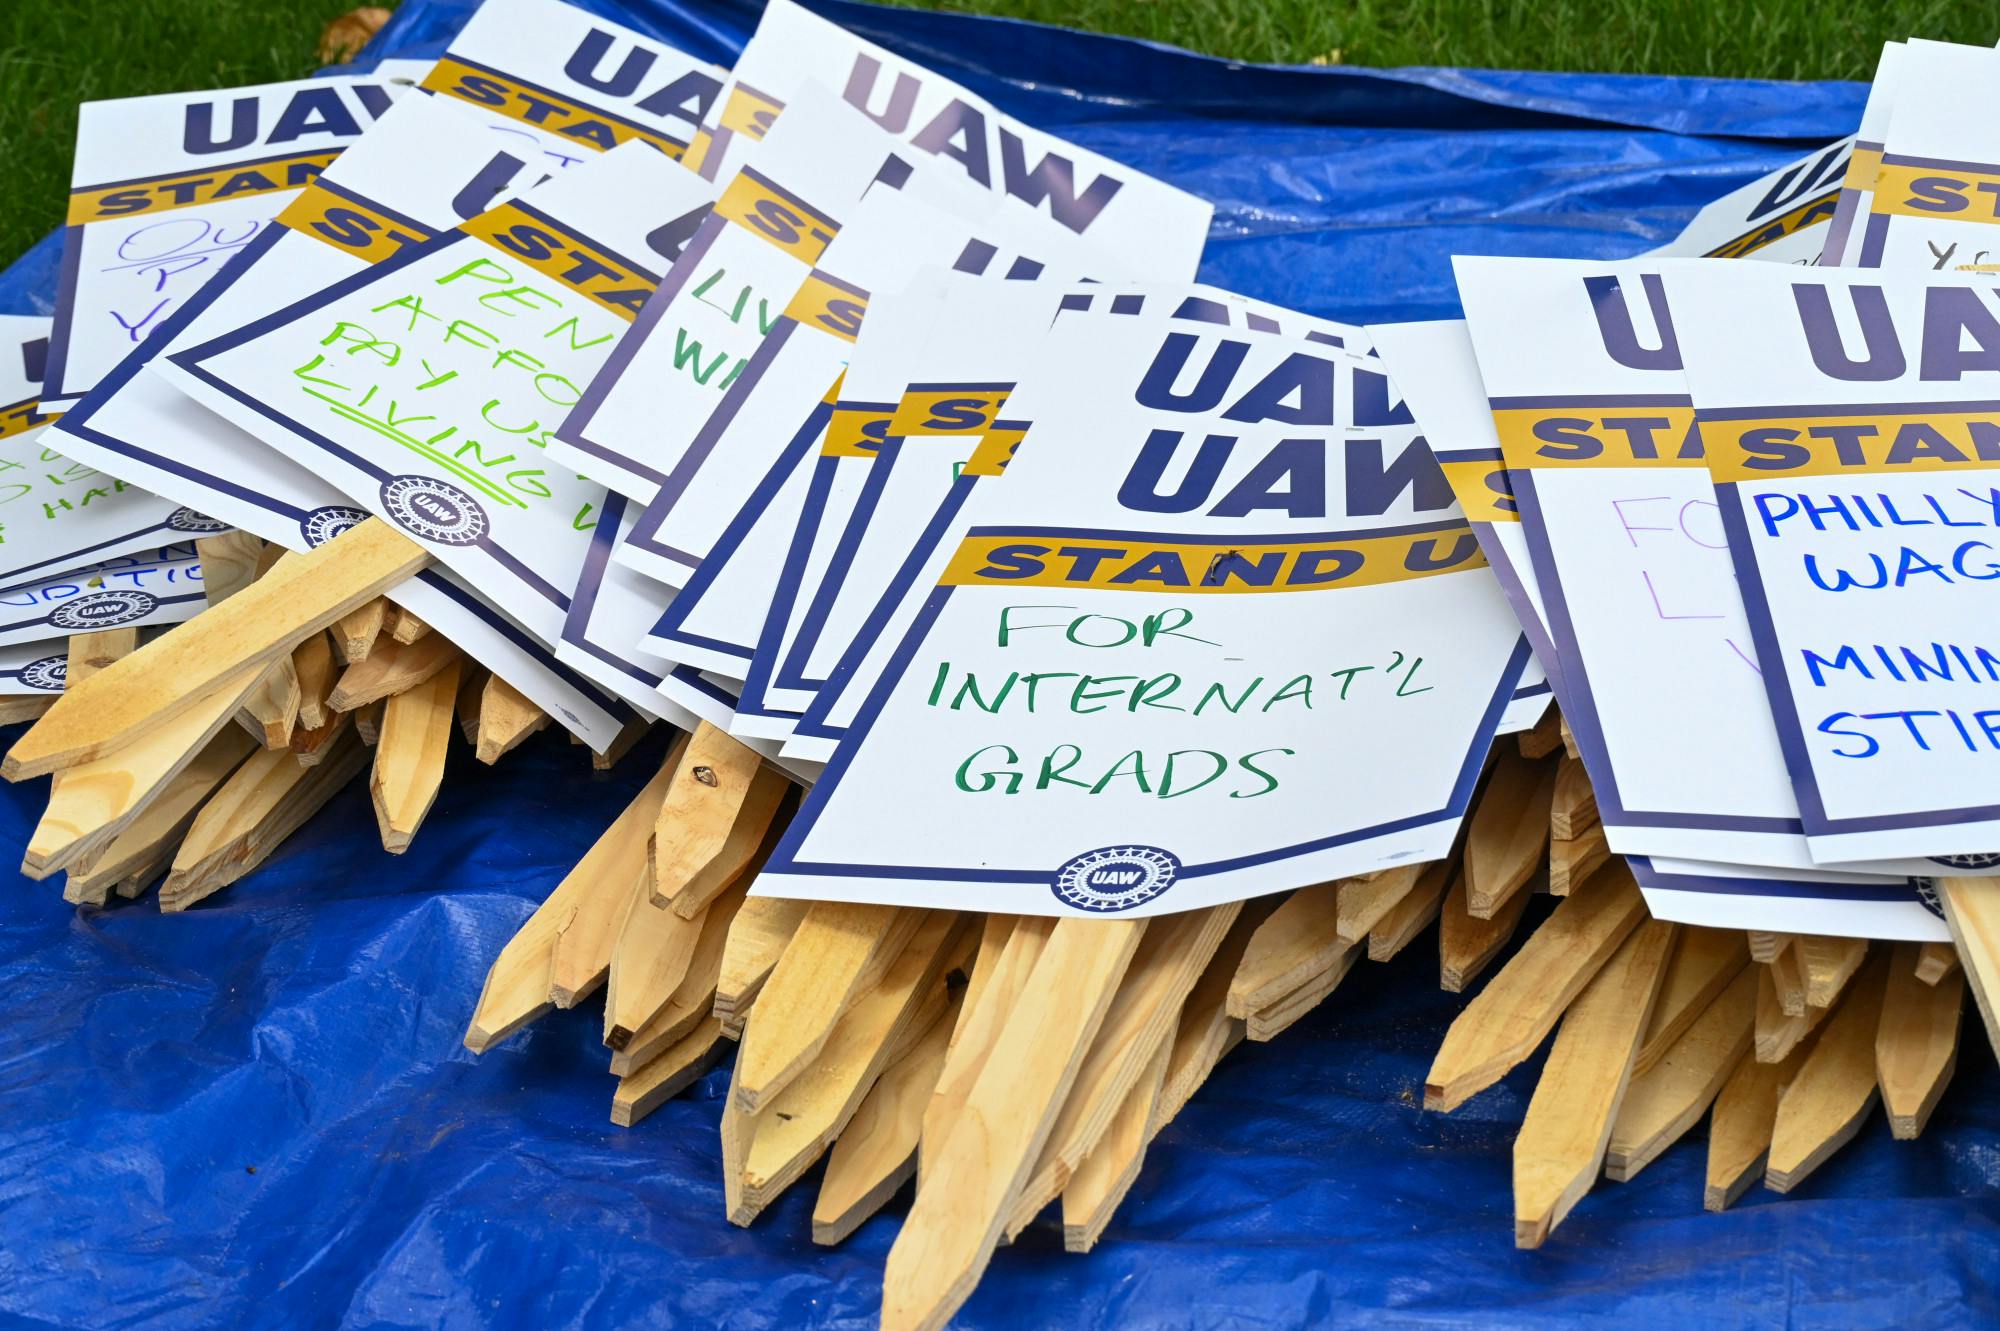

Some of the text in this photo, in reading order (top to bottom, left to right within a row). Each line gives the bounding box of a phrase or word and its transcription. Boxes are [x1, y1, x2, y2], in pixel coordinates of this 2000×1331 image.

[451, 75, 683, 163] STA
[842, 51, 1125, 235] UAW
[319, 322, 459, 391] PAY
[1791, 283, 2000, 382] UA
[294, 354, 551, 498] LIVING
[1117, 429, 1457, 518] UAW
[415, 495, 457, 521] UAW
[974, 545, 1365, 587] STAND
[82, 603, 124, 617] UAW
[998, 606, 1222, 648] FOR
[927, 650, 1435, 716] INTERNAT'L
[954, 744, 1296, 799] GRADS
[1091, 871, 1142, 885] UAW
